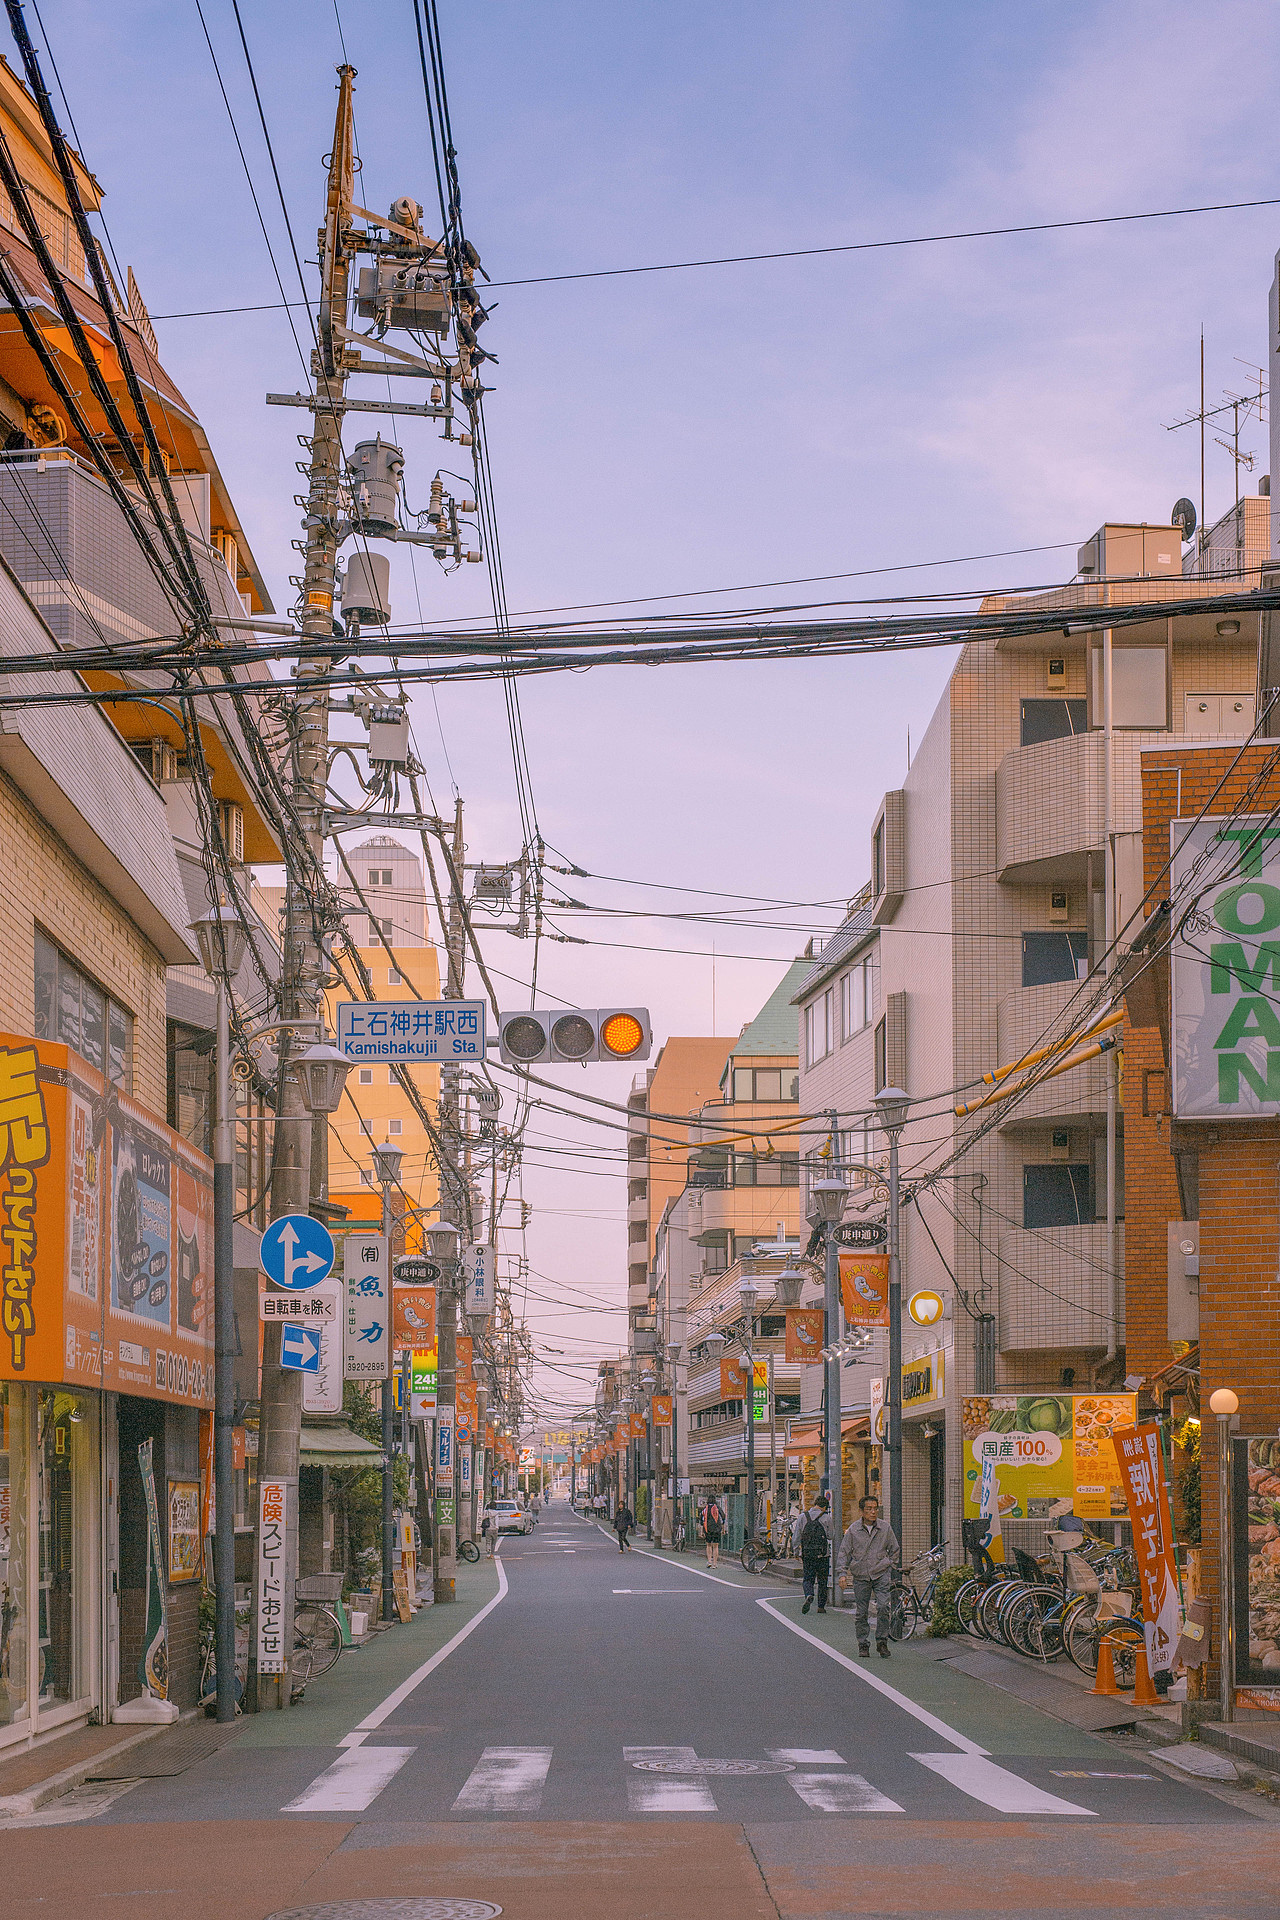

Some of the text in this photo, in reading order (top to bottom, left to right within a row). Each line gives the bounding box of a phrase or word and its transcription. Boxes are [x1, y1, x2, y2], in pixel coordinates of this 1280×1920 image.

[344, 1010, 478, 1036] 上石神井駅西
[344, 1040, 478, 1056] Kamishakujii Sta.
[142, 1153, 166, 1186] ロレックス
[361, 1246, 379, 1262] (有)
[475, 1258, 484, 1297] 小林眼科
[264, 1299, 332, 1316] 自転車を除く
[852, 1304, 880, 1316] 地元
[347, 1362, 385, 1372] 3920-2895
[441, 1429, 450, 1465] マルイチ
[983, 1440, 1053, 1457] 国産100%
[440, 1506, 453, 1520] 文
[261, 1485, 283, 1653] 危険スピードおとせ
